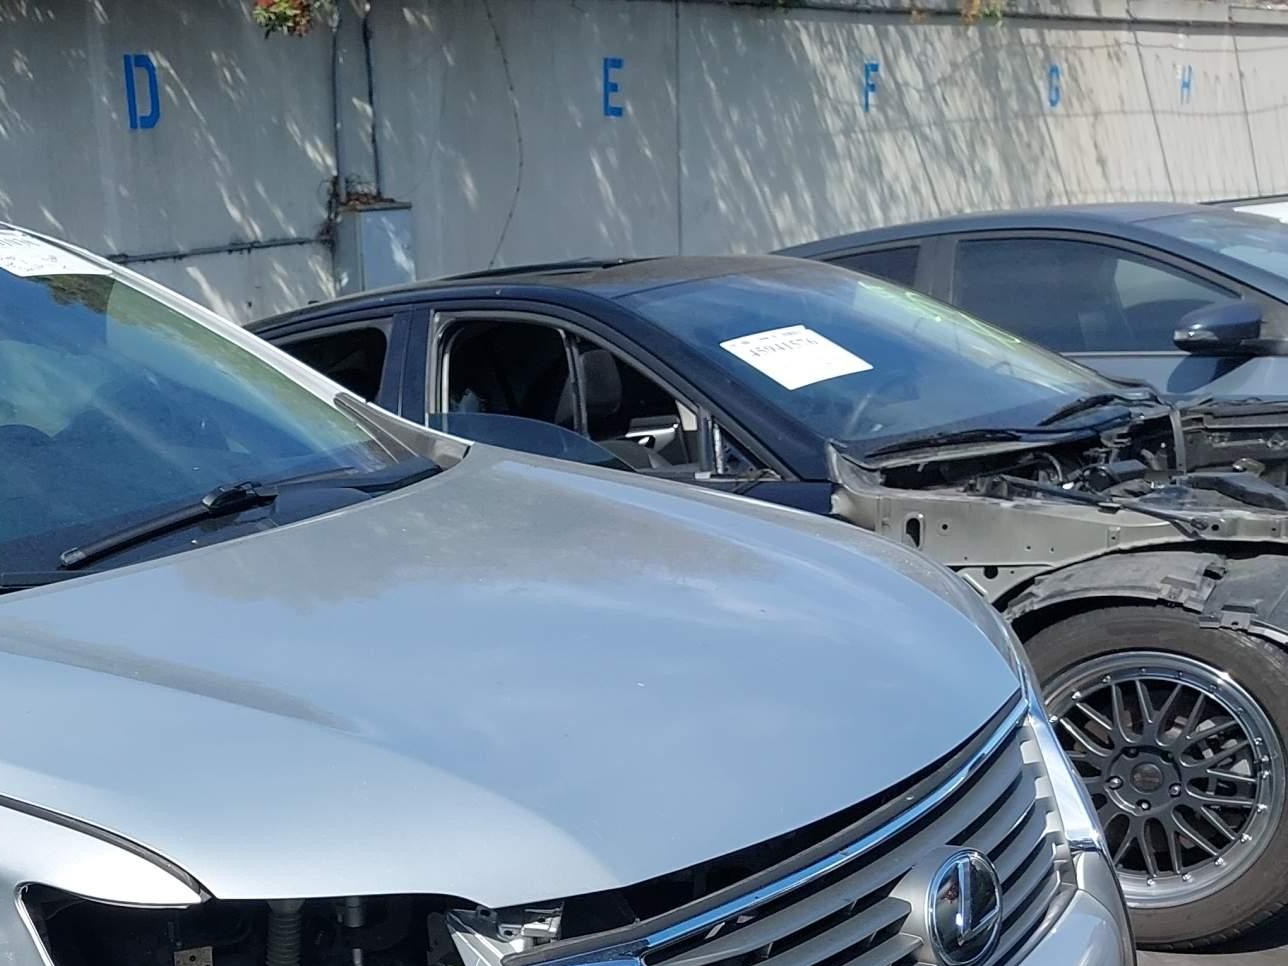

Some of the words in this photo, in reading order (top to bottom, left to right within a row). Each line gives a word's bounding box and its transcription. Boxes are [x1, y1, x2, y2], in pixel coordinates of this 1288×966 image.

[123, 53, 162, 131] D
[601, 56, 626, 119] E
[863, 62, 880, 112] F
[1047, 64, 1062, 107] G
